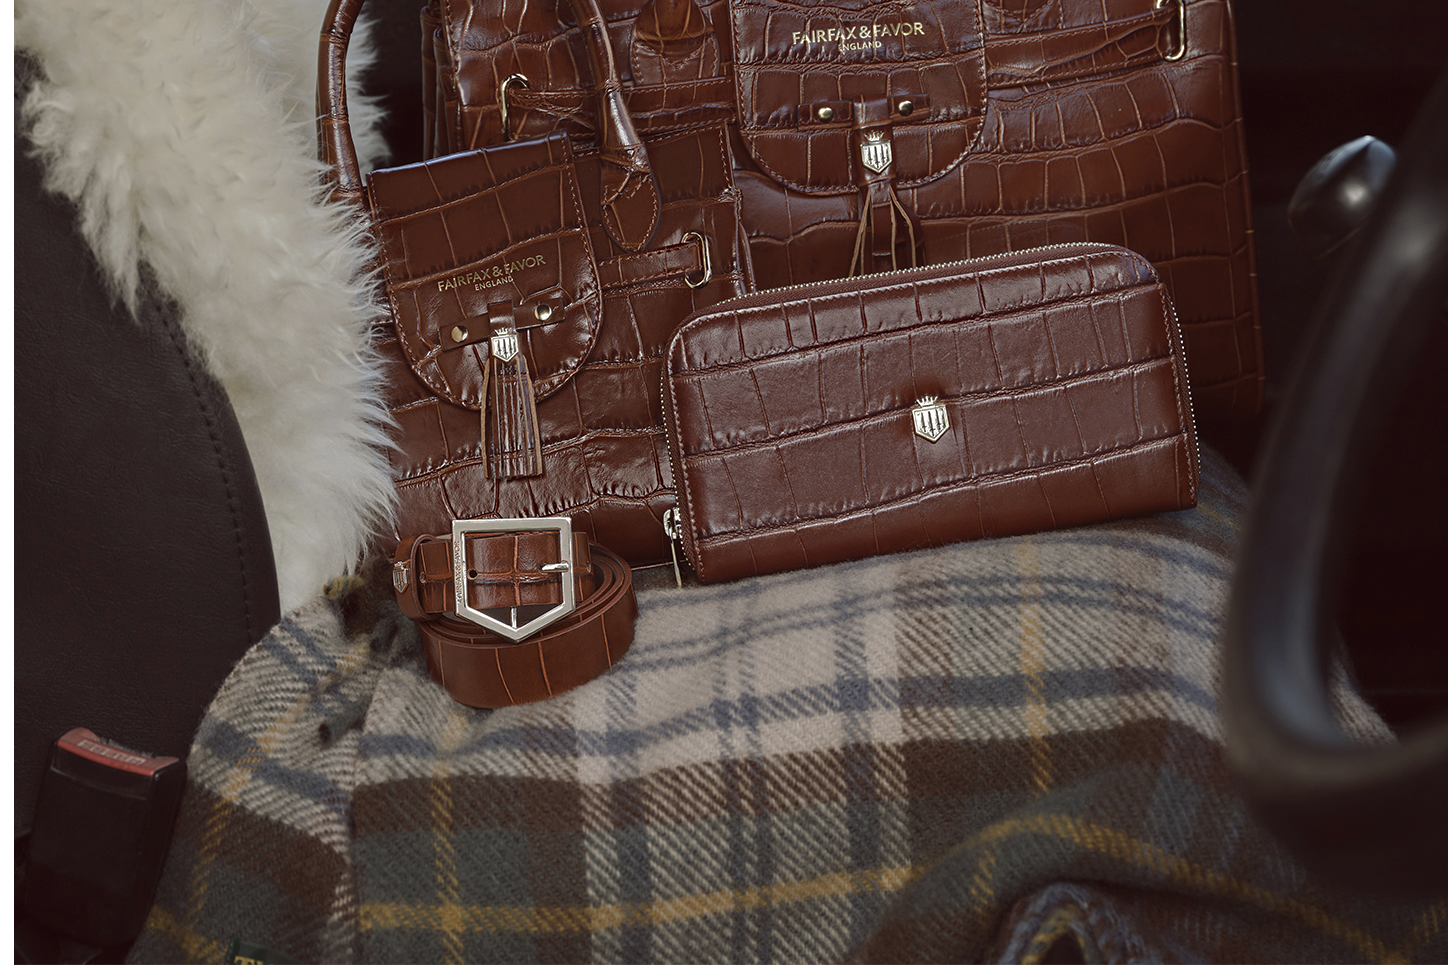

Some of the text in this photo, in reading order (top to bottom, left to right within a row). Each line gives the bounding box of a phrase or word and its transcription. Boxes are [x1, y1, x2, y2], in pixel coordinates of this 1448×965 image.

[792, 22, 925, 45] FAIRFAX & FAVOR
[838, 40, 882, 52] ENGLAND
[437, 254, 546, 292] FAIRFAX & FAVOR
[474, 275, 514, 291] ENGLAND
